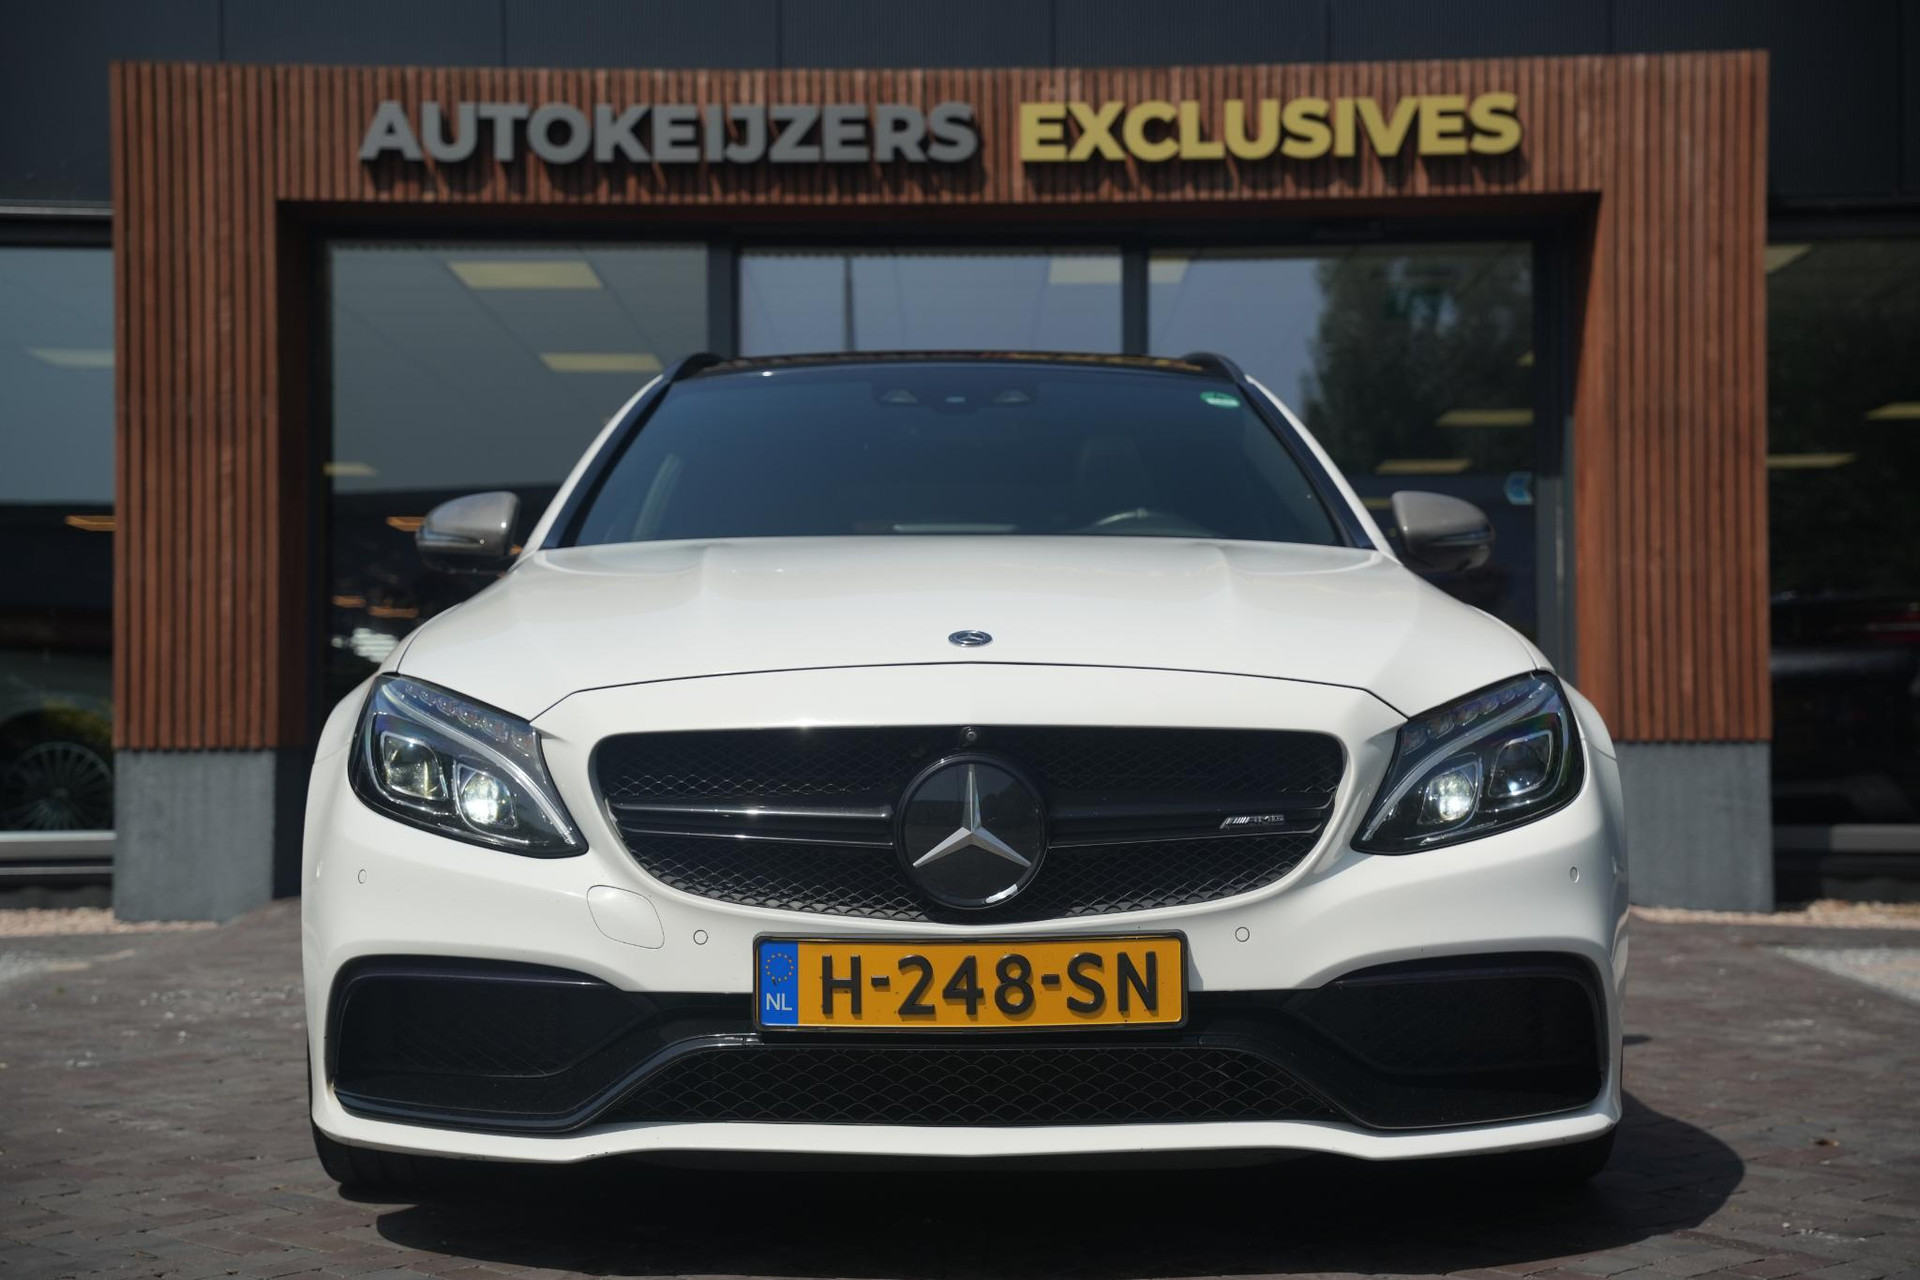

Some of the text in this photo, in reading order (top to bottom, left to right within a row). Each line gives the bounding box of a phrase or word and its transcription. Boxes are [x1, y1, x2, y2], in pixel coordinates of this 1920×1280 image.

[359, 92, 1523, 165] AUTOKEIJZERS EXCLUSIVES
[765, 992, 793, 1011] NL
[821, 951, 1158, 1017] H-248-SN
